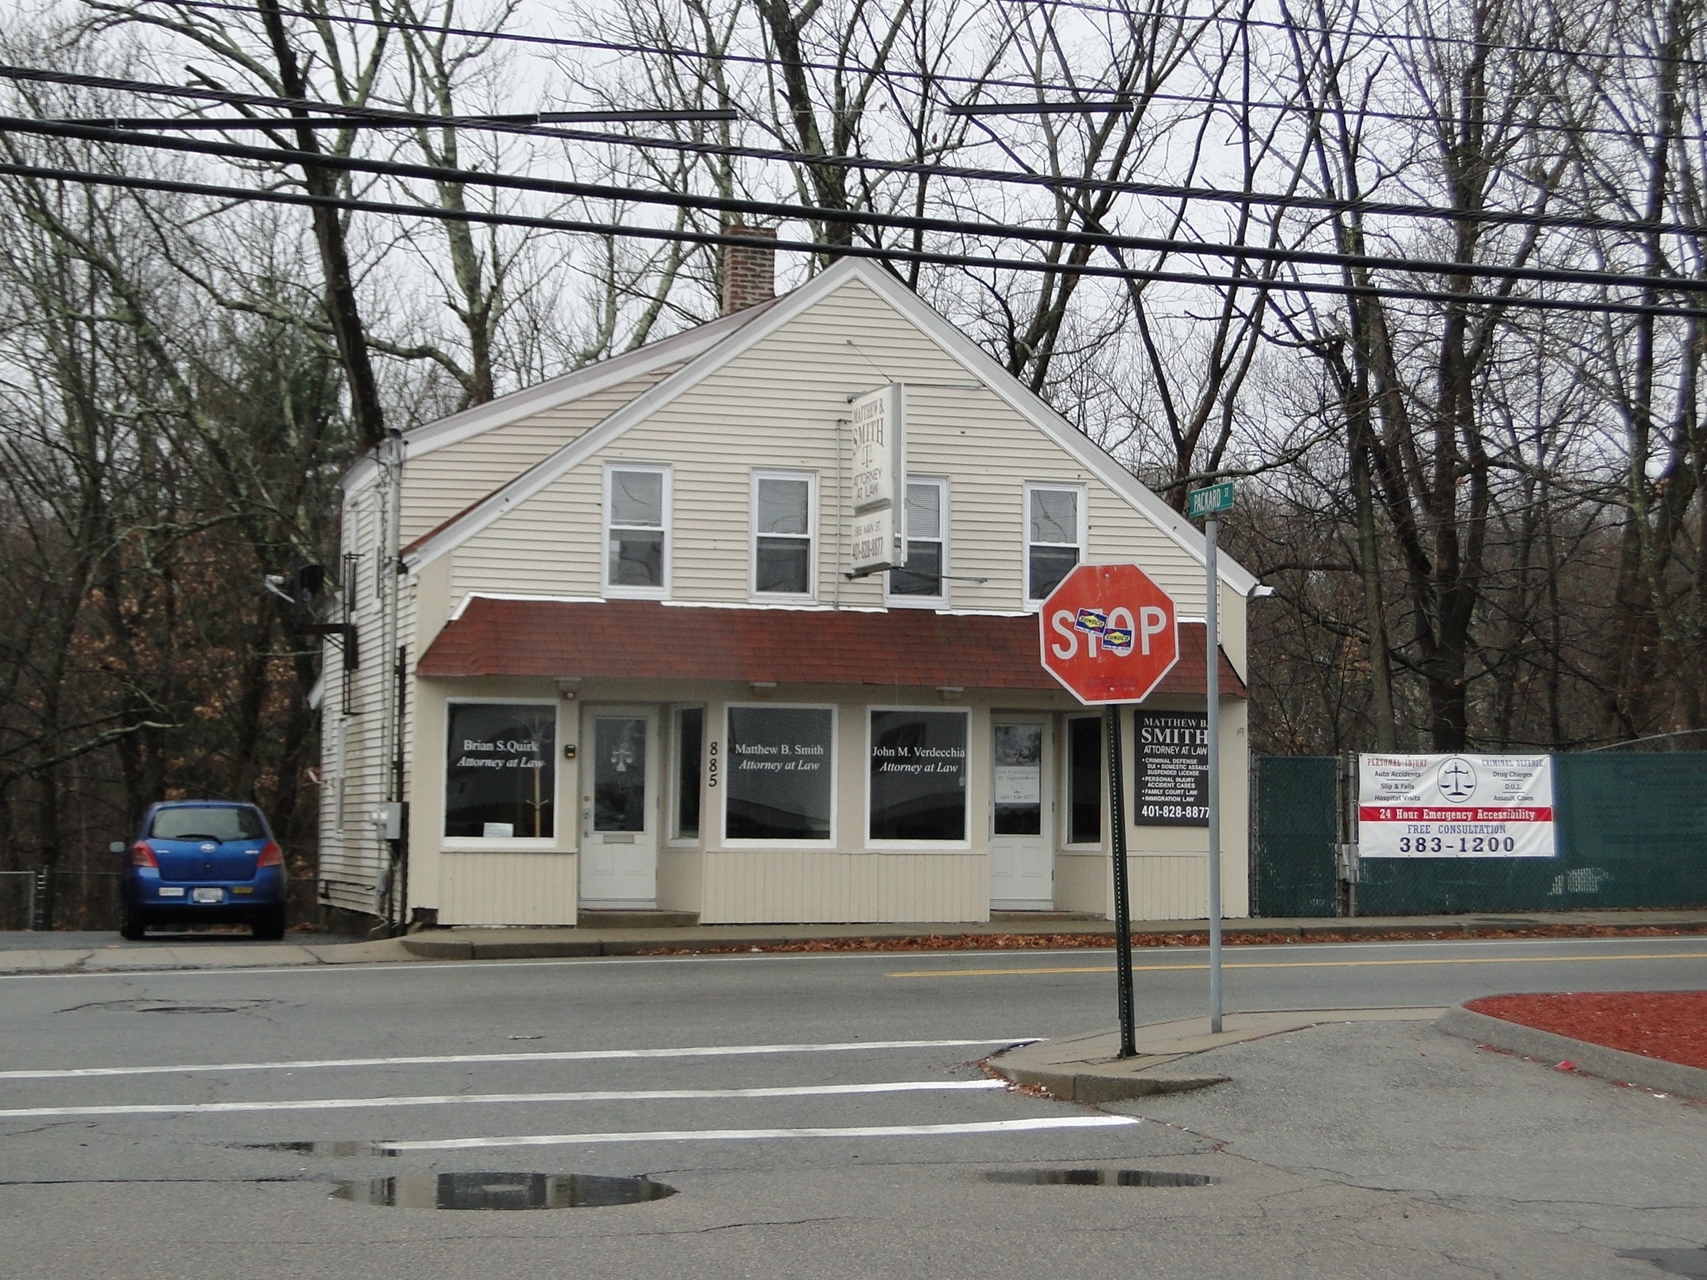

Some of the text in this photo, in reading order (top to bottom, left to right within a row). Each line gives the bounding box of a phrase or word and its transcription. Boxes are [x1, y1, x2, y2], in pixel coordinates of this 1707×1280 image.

[854, 400, 878, 424] MATTHEW
[852, 418, 884, 456] SMITH
[854, 467, 882, 487] ATTORNEY
[856, 482, 878, 500] AT LAW
[1194, 488, 1229, 512] PACKARD ST
[864, 522, 874, 534] MAIN
[1080, 615, 1104, 628] SUNOCO
[1052, 606, 1166, 660] STOP
[1106, 634, 1130, 642] SUNOCO
[1144, 718, 1198, 727] MATTHEW
[1141, 728, 1208, 744] SMITH
[464, 740, 493, 751] Brian
[735, 744, 824, 755] Matthew B. Smith
[1144, 745, 1207, 755] ATTORNEY AT LAW
[872, 746, 965, 758] John M. Verdecchia
[457, 756, 545, 770] Attorney at Law
[708, 742, 718, 788] 885
[739, 760, 820, 772] Attorney at Law
[880, 762, 958, 774] Attorney at Law
[1367, 758, 1401, 767] PERSONAL
[1482, 759, 1514, 767] CRIMINAL
[1492, 771, 1533, 779] Drug Charges
[1374, 794, 1402, 803] Hospital
[1141, 806, 1209, 819] 401-828-8877
[1379, 808, 1536, 822] 24 Hour Emergency Accessibility
[1407, 824, 1506, 834] FREE CONSULTATION
[1399, 837, 1514, 853] 383-1200
